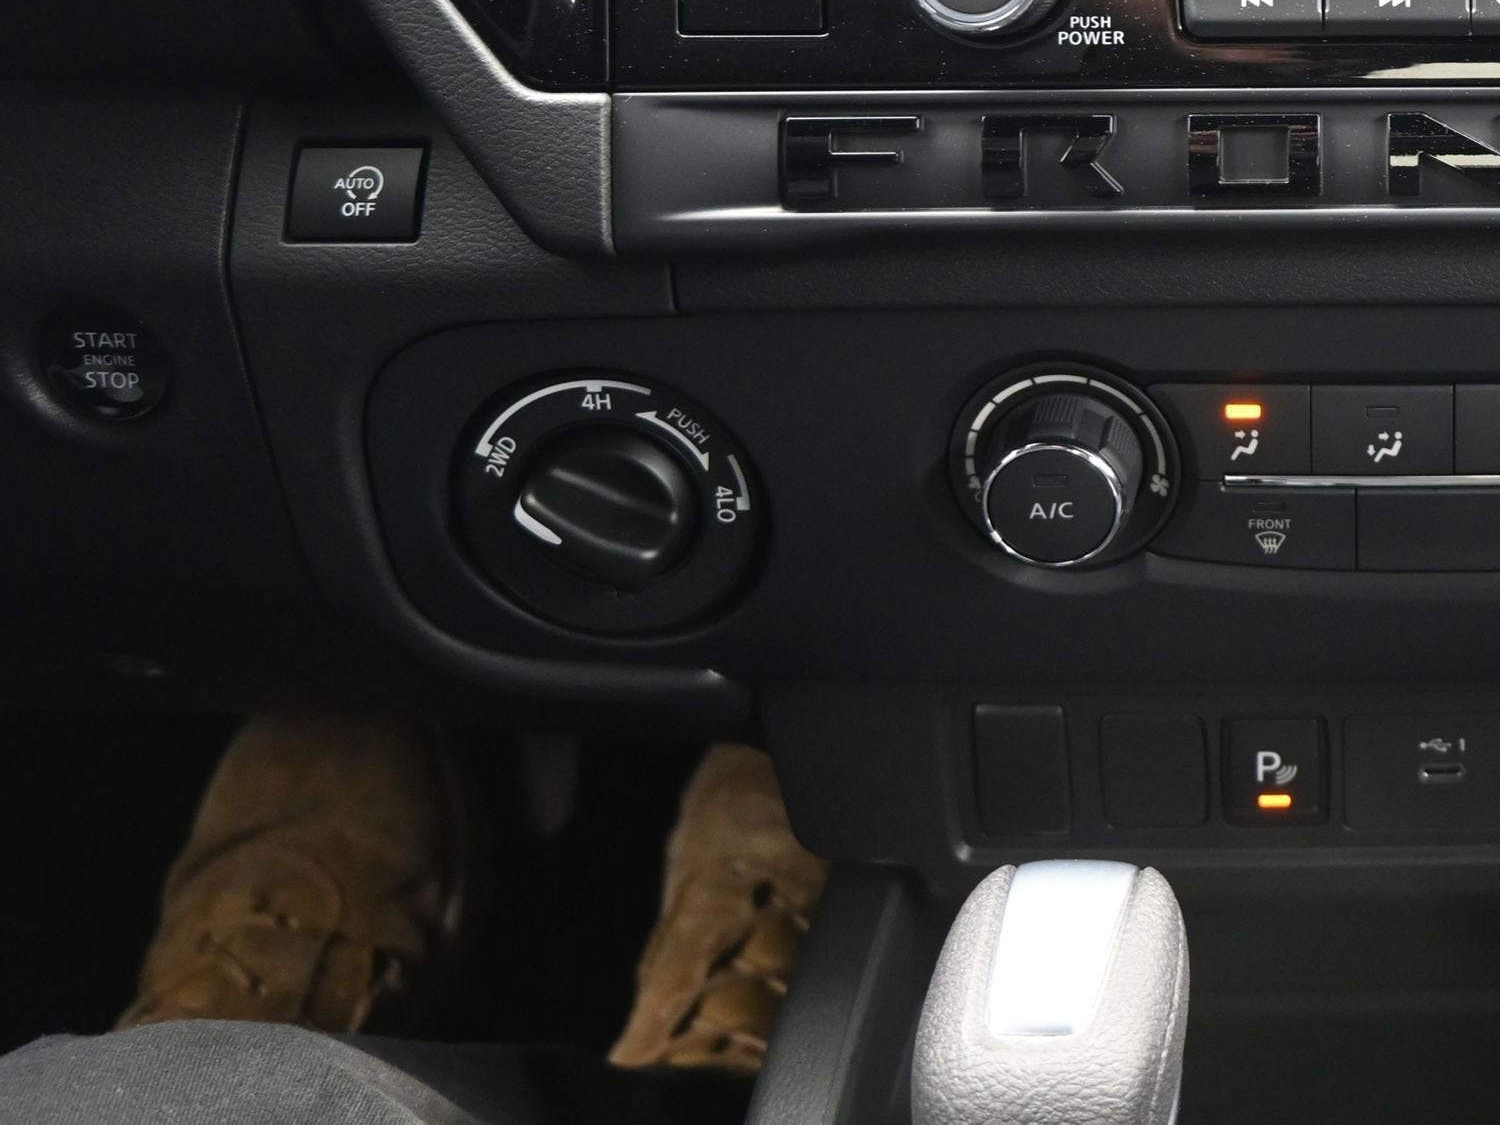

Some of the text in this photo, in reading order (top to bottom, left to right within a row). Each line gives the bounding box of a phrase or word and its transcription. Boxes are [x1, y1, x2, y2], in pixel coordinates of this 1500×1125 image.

[1069, 15, 1112, 30] PUSH
[1057, 30, 1125, 46] POWER
[334, 177, 375, 190] AUTO
[341, 202, 377, 217] OFF
[73, 331, 137, 349] START
[83, 354, 136, 367] ENGINE
[85, 371, 140, 390] STOP
[581, 393, 612, 411] 4H
[666, 407, 711, 445] PUSH
[485, 435, 517, 478] 2WD
[714, 485, 737, 524] 4LO
[1029, 501, 1074, 520] A/C
[1248, 518, 1292, 530] FRONT
[1458, 737, 1467, 752] 1
